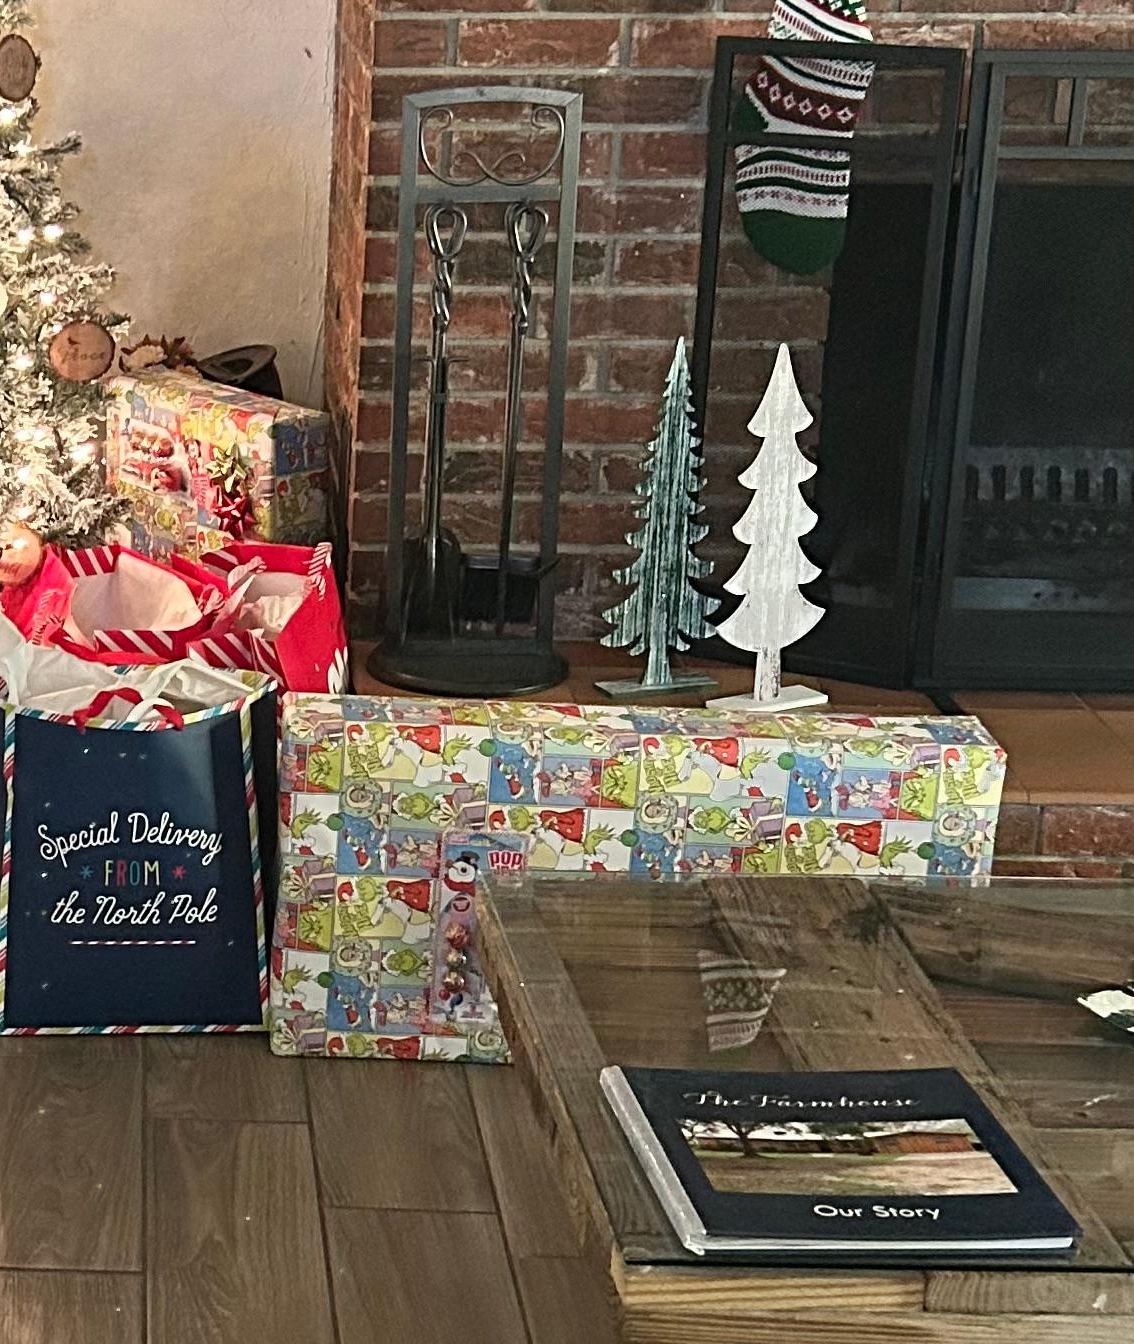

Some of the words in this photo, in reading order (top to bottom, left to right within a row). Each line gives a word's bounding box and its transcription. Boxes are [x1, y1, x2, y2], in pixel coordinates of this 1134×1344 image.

[37, 811, 120, 868] Special
[128, 811, 223, 865] Delivery
[104, 859, 160, 887] FROM
[50, 890, 85, 924] the
[92, 891, 165, 925] North
[168, 887, 218, 924] Pole
[682, 1090, 748, 1107] The
[750, 1094, 921, 1108] Farmhouse
[813, 1204, 864, 1218] Our
[872, 1205, 940, 1221] Story
